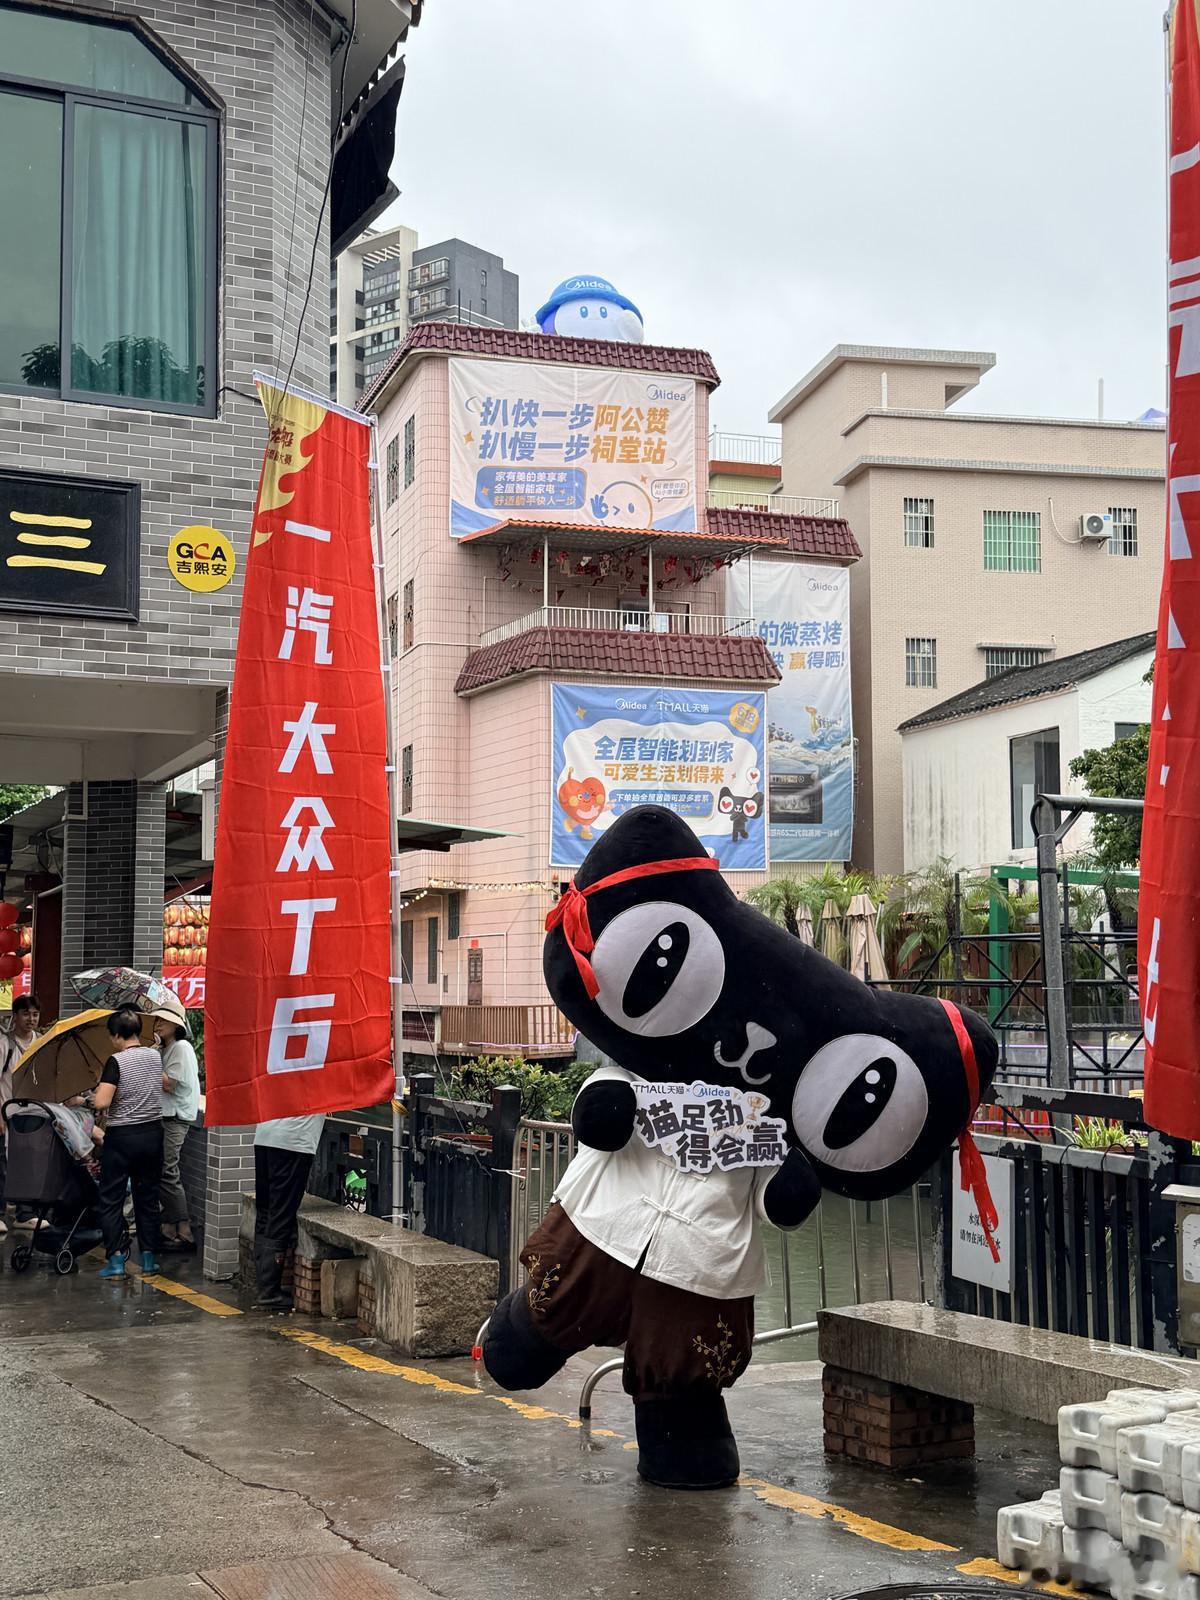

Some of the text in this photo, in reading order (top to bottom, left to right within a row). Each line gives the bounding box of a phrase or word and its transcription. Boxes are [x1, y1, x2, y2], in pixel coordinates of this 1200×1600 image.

[650, 387, 687, 402] Midea
[480, 396, 670, 436] 扒快一步阿公赞
[478, 430, 668, 465] 扒慢一步祠堂站
[175, 541, 228, 562] GCA
[175, 560, 228, 577] 吉熙安
[810, 580, 839, 592] Midea
[618, 699, 647, 710] Midea
[594, 735, 734, 763] 全屋智能划到家
[604, 763, 725, 784] 可爱生活划得来
[694, 1084, 731, 1098] Midea
[635, 1099, 744, 1143] 猫足劲
[676, 1121, 786, 1169] 得会赢
